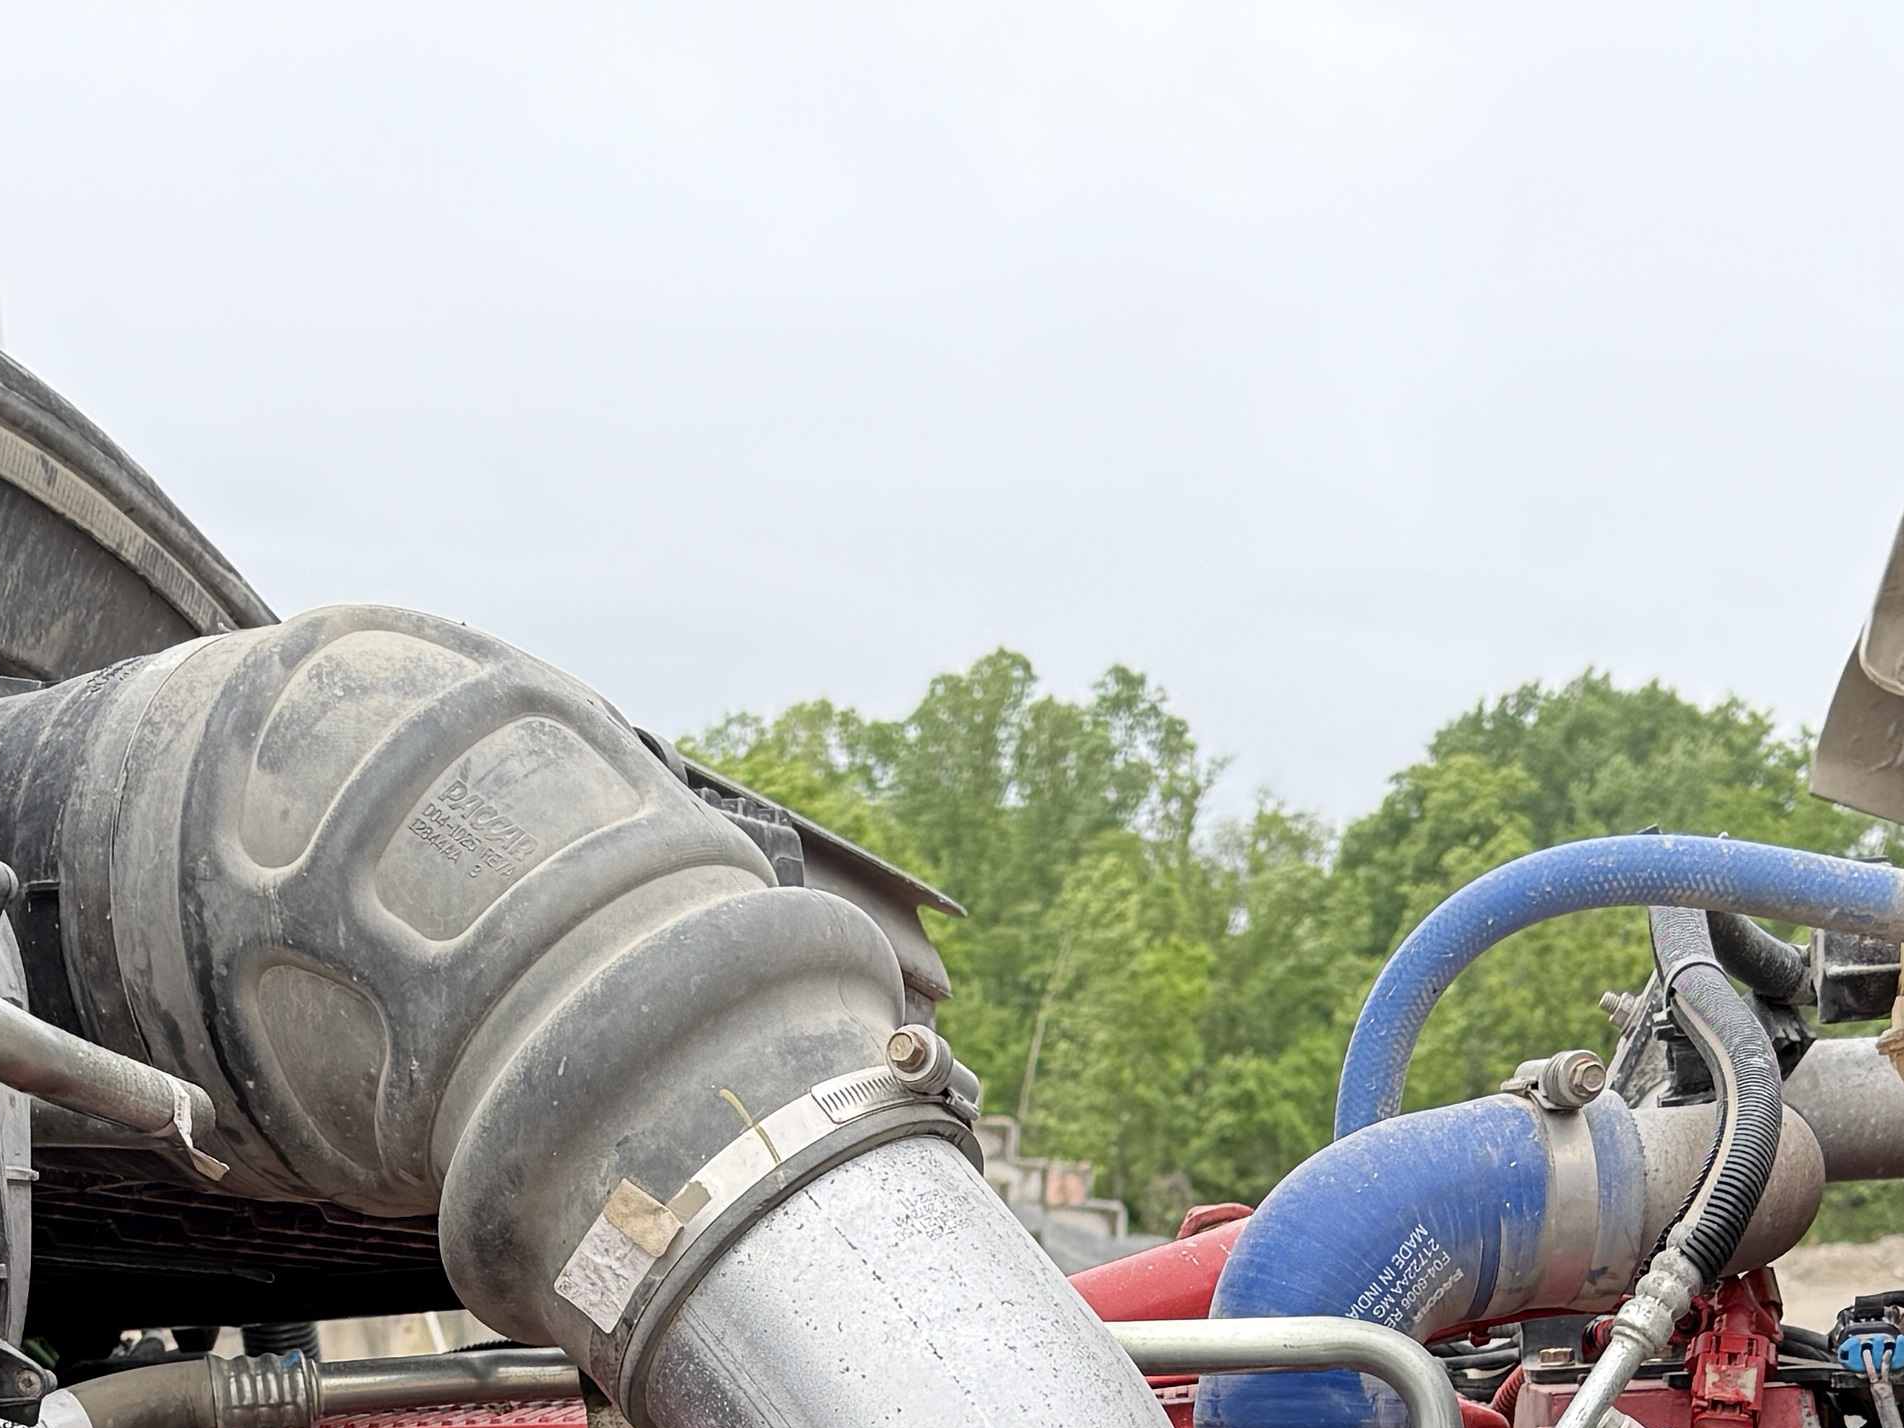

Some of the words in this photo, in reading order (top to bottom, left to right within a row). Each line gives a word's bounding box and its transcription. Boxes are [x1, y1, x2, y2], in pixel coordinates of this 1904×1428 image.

[438, 779, 539, 862] PACCAR
[1390, 1238, 1439, 1295] 21722AA
[1391, 1224, 1428, 1269] MADE
[1378, 1266, 1395, 1285] IN
[1401, 1251, 1451, 1309] F04-6006
[1345, 1282, 1382, 1319] INDIA
[1373, 1294, 1395, 1318] MG
[1384, 1308, 1403, 1328] RE
